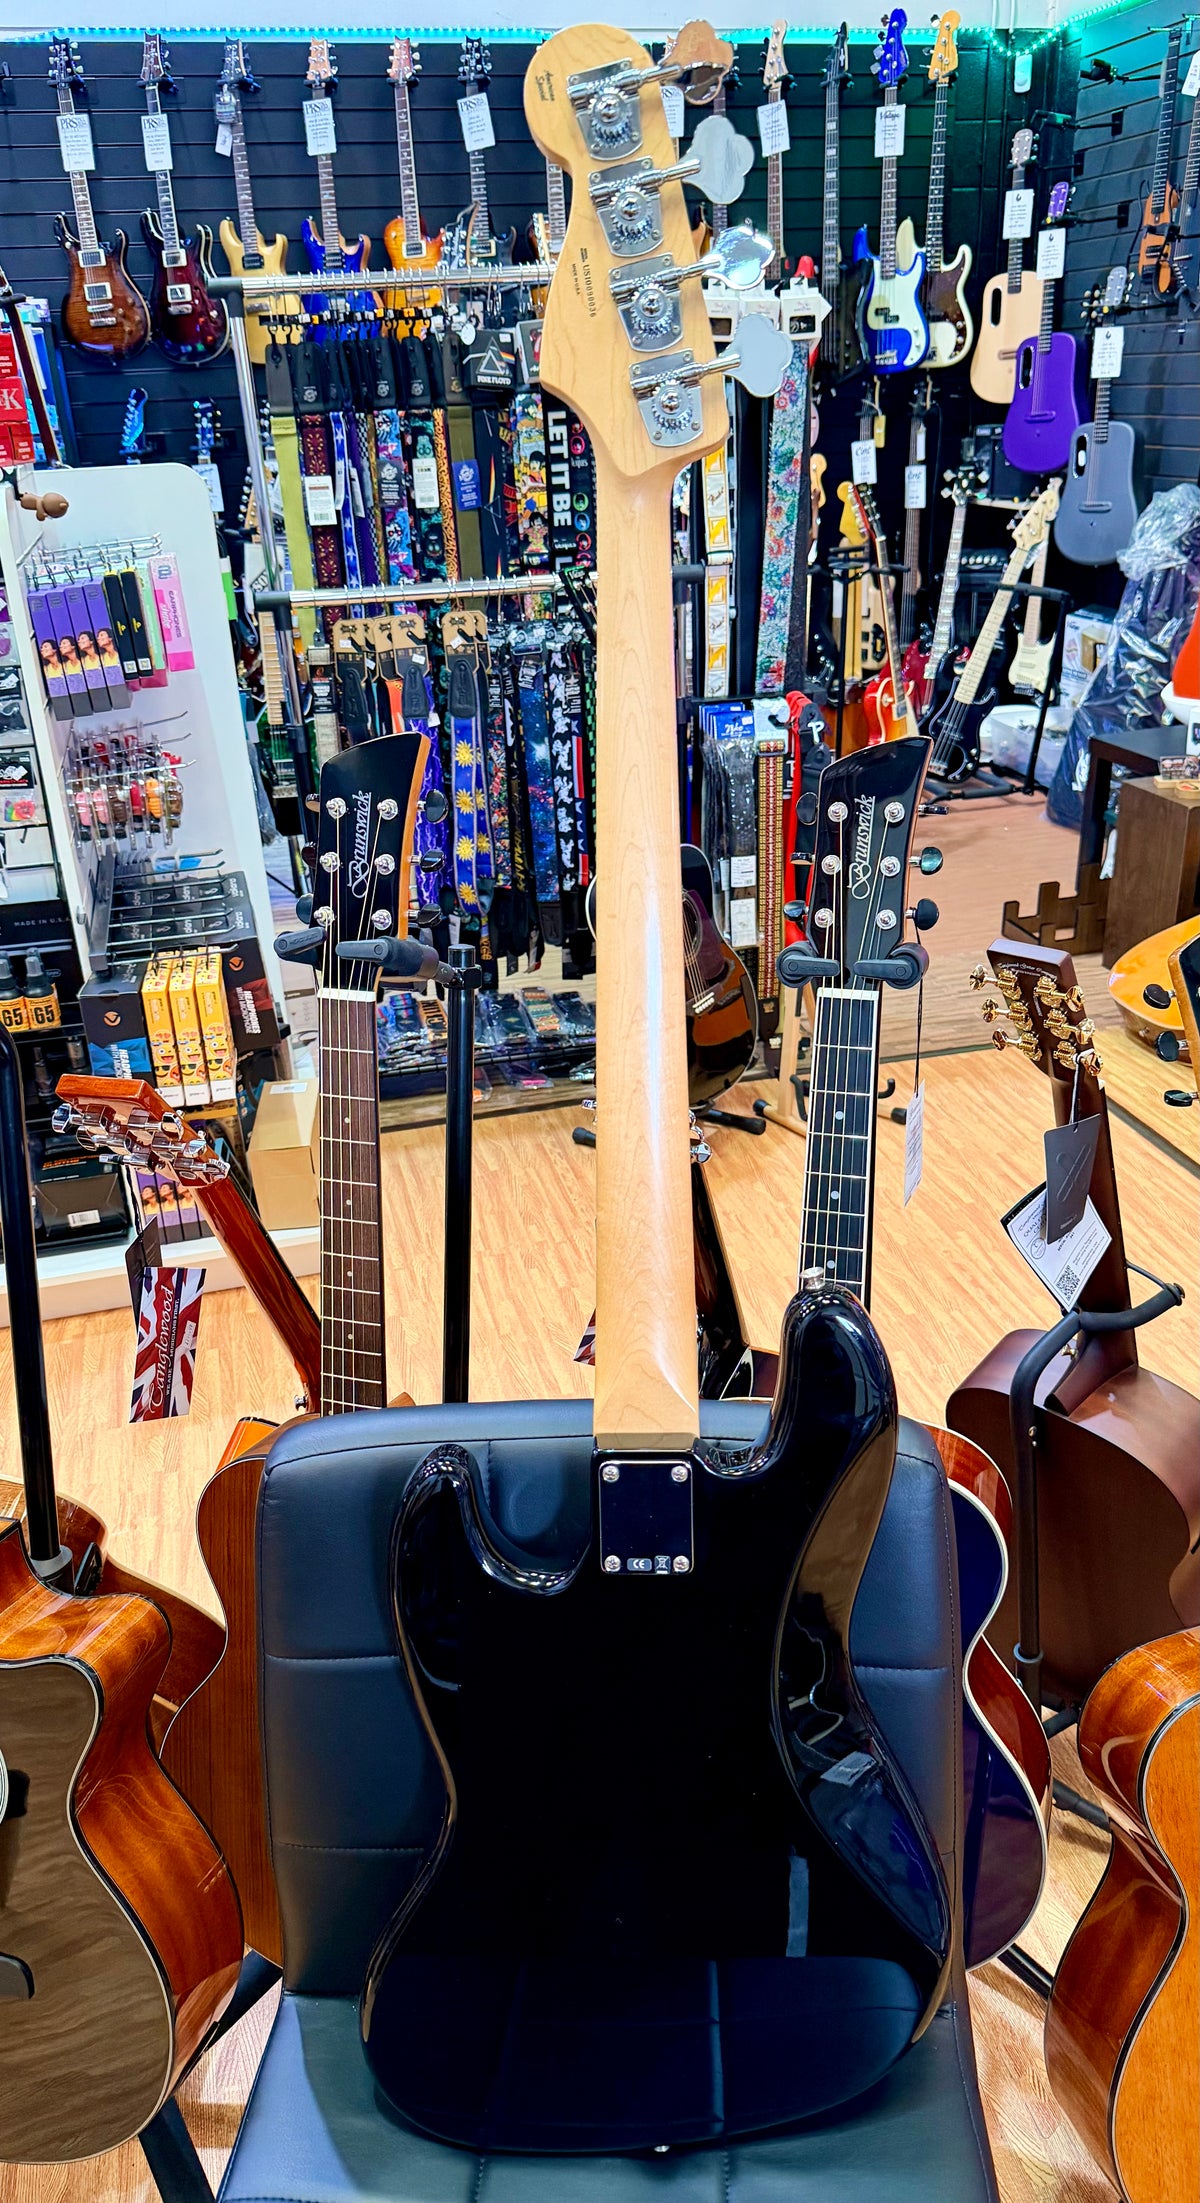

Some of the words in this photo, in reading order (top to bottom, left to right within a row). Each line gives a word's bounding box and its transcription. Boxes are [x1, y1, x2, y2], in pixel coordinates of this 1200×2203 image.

[305, 101, 321, 115] PRS
[460, 98, 477, 112] PRS
[60, 118, 78, 130] PRS
[143, 118, 159, 130] PRS
[492, 376, 511, 386] FLOYD
[547, 411, 569, 460] LET
[551, 463, 571, 490] IT
[552, 493, 572, 527] BE
[168, 590, 182, 638] EARPHONES
[347, 790, 372, 898] Brunswick
[847, 793, 876, 900] Brunswick
[2, 1007, 24, 1027] 65
[33, 1004, 56, 1025] 65
[239, 1003, 251, 1034] MICROPHONE
[244, 990, 262, 1034] HEADPHONES
[119, 1048, 133, 1079] HEADPH
[149, 1284, 174, 1414] Tanglewood
[170, 1323, 178, 1357] MUSICIANS
